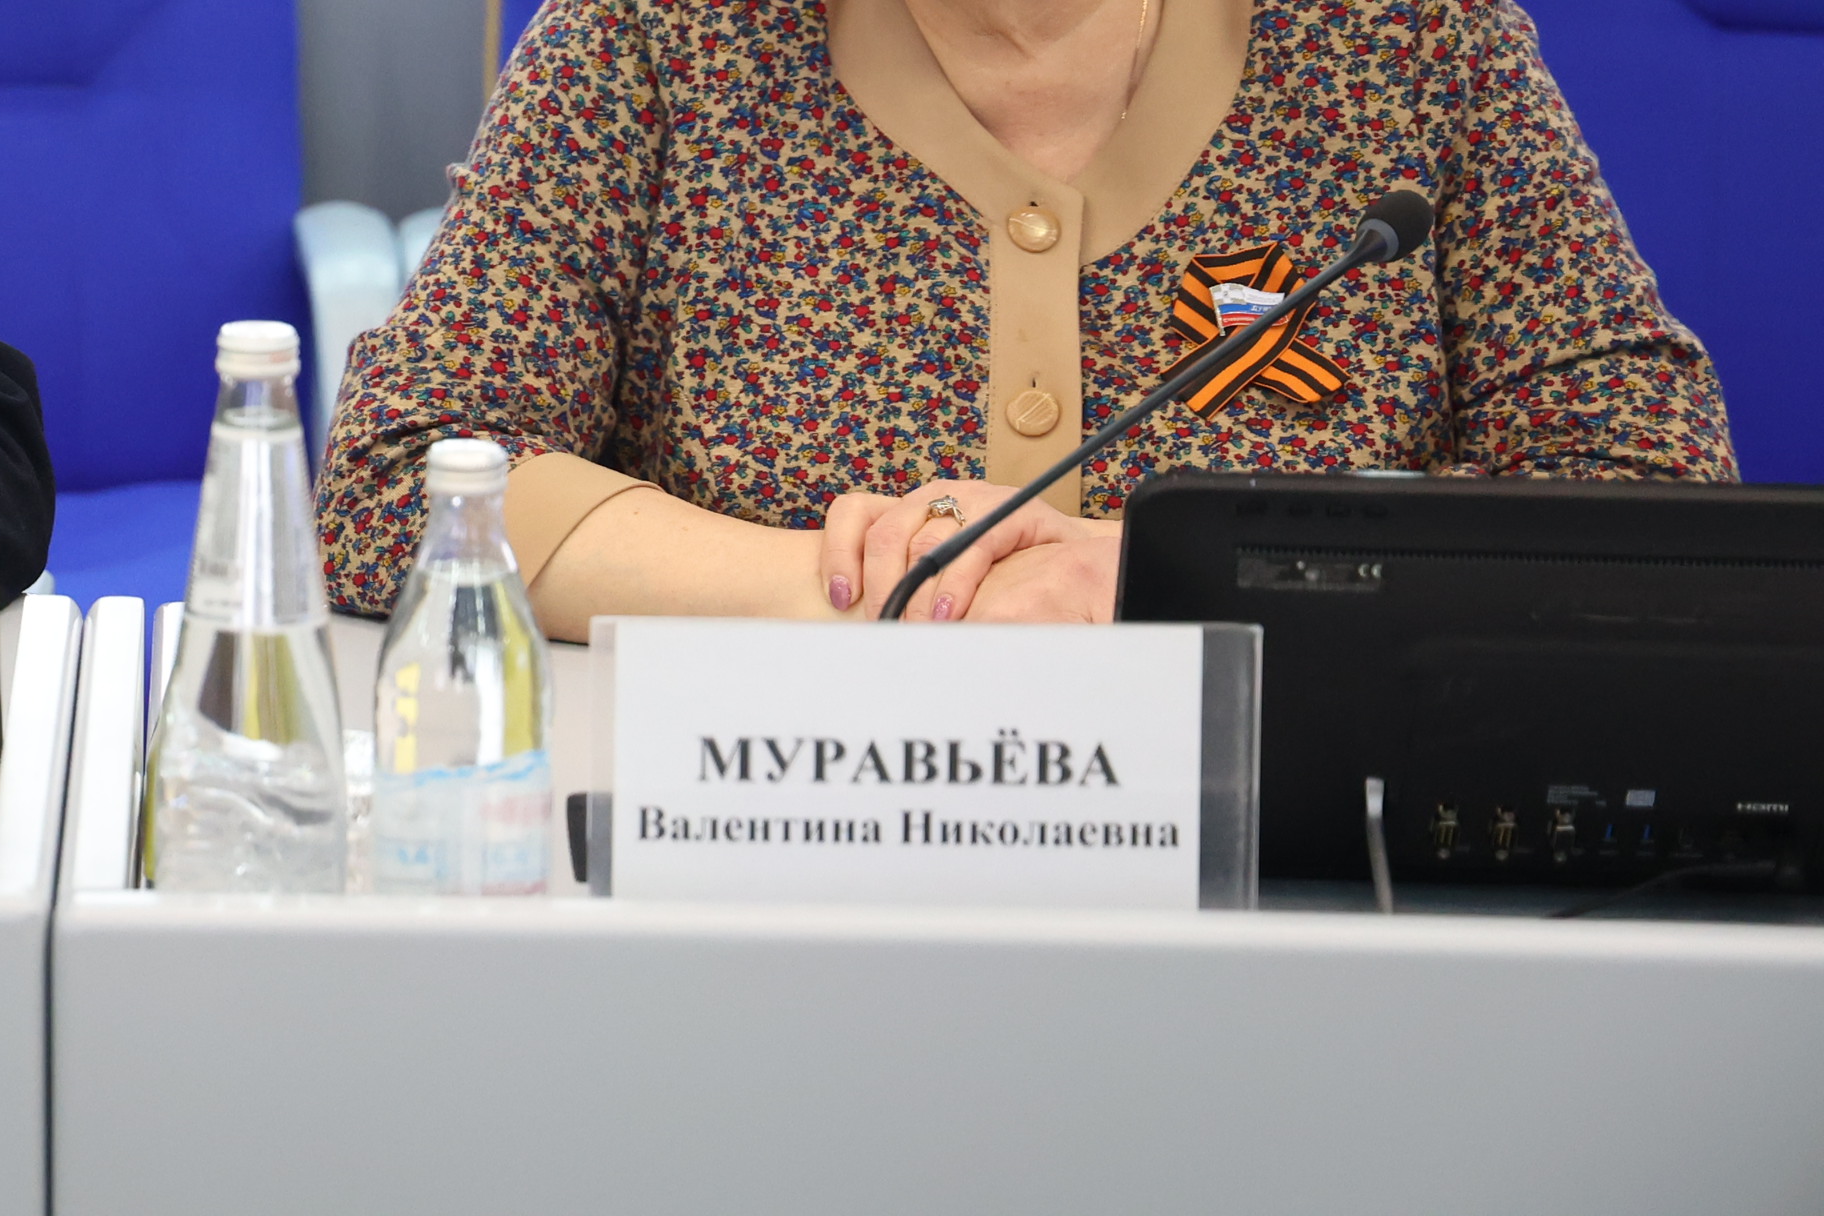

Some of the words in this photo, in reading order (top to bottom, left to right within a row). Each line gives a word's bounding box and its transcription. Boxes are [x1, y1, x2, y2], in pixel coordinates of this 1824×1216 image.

[700, 728, 1120, 786] МУРАВЬЁВА
[638, 806, 881, 844] Валентина
[901, 810, 1180, 848] Николаевна
